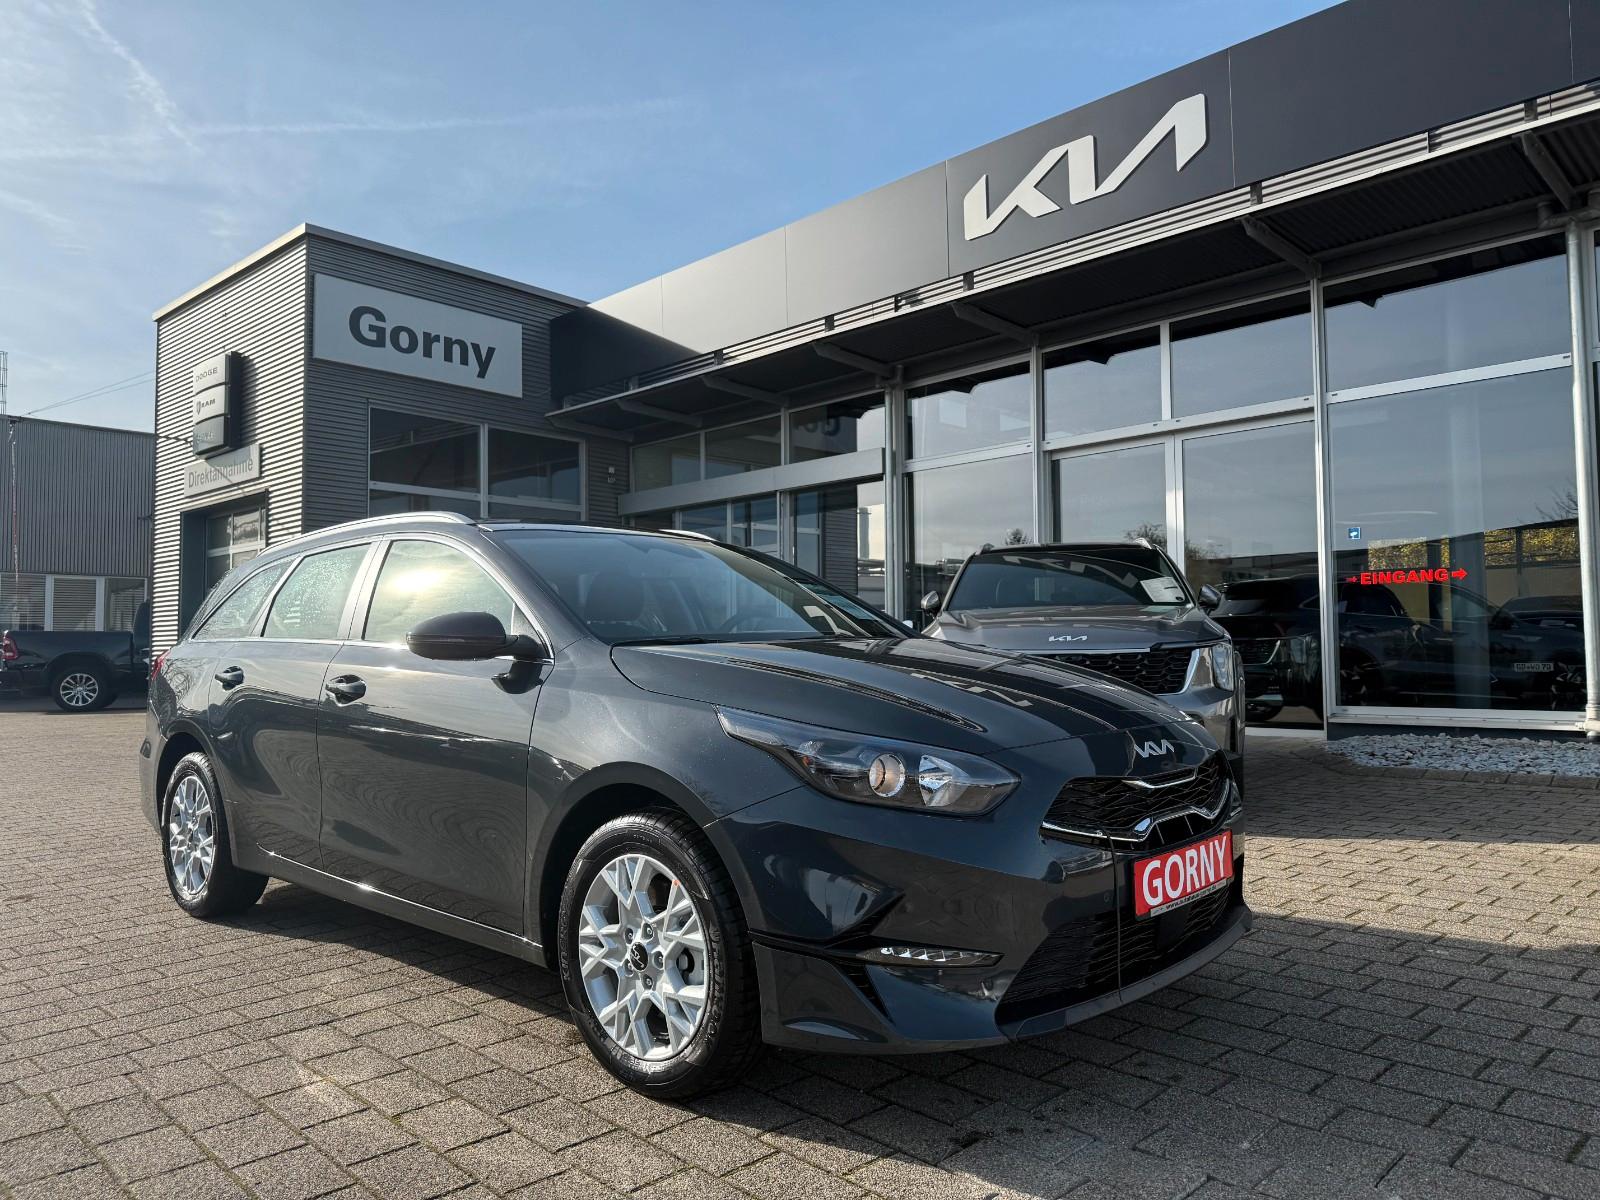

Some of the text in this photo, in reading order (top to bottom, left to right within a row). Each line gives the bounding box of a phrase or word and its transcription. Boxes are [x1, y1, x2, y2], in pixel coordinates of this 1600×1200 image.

[963, 93, 1207, 241] KIA
[348, 305, 496, 379] Gorny
[195, 366, 218, 383] DODGE
[188, 458, 254, 488] Direktannahme
[1360, 568, 1449, 585] EINGANG
[1142, 835, 1227, 906] GORNY
